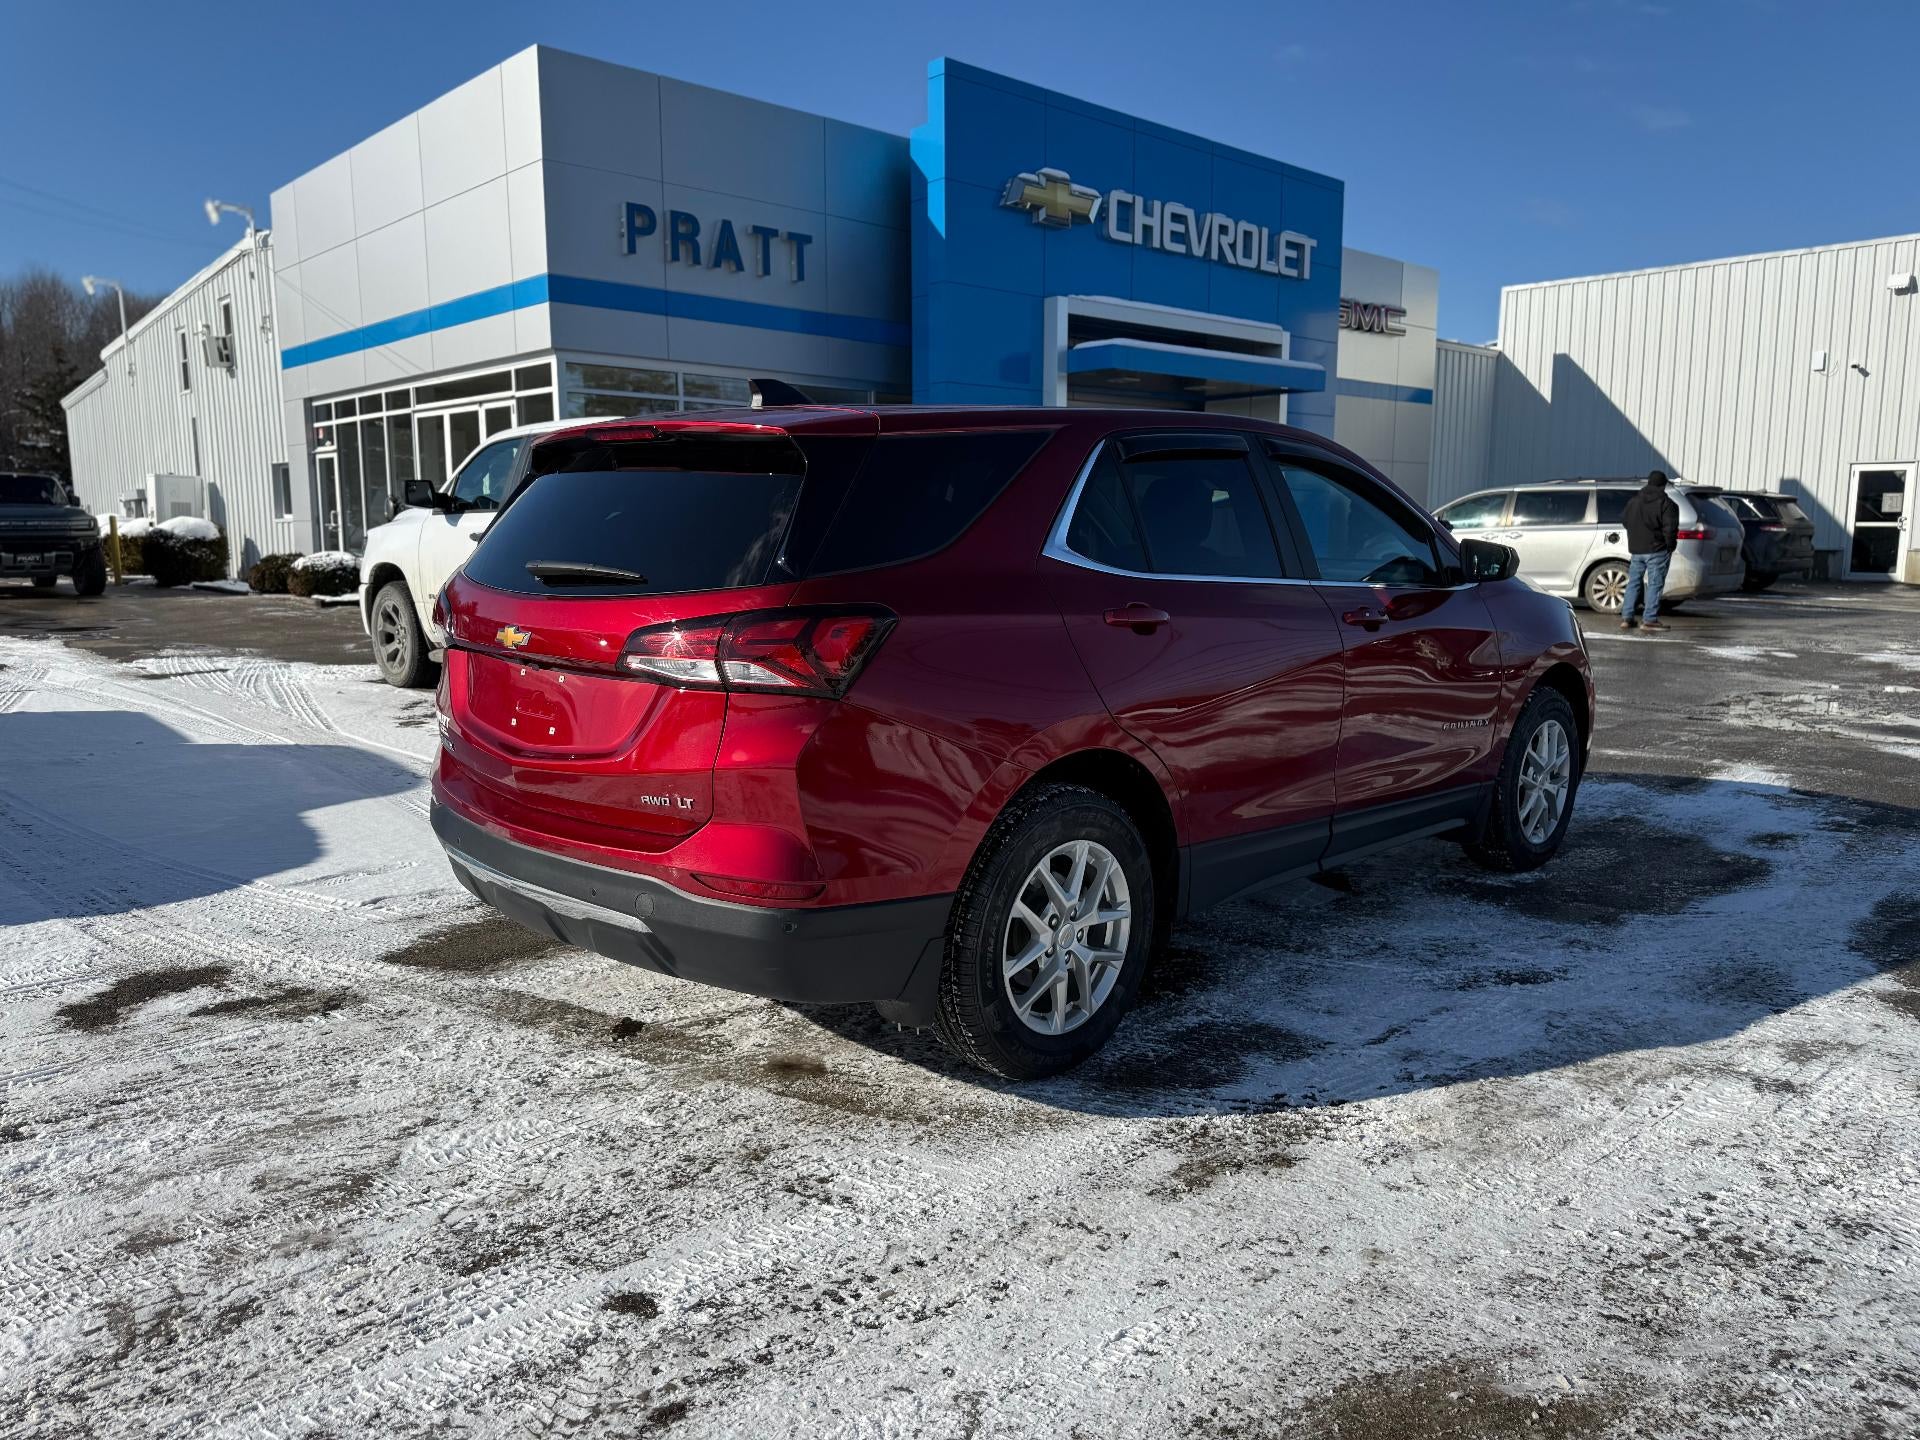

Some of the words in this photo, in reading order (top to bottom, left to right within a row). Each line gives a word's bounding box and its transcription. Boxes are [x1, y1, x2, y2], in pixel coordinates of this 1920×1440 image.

[622, 201, 813, 283] PRATT
[1106, 189, 1318, 280] CHEVROLET
[641, 795, 670, 807] AWD
[677, 797, 694, 810] LT
